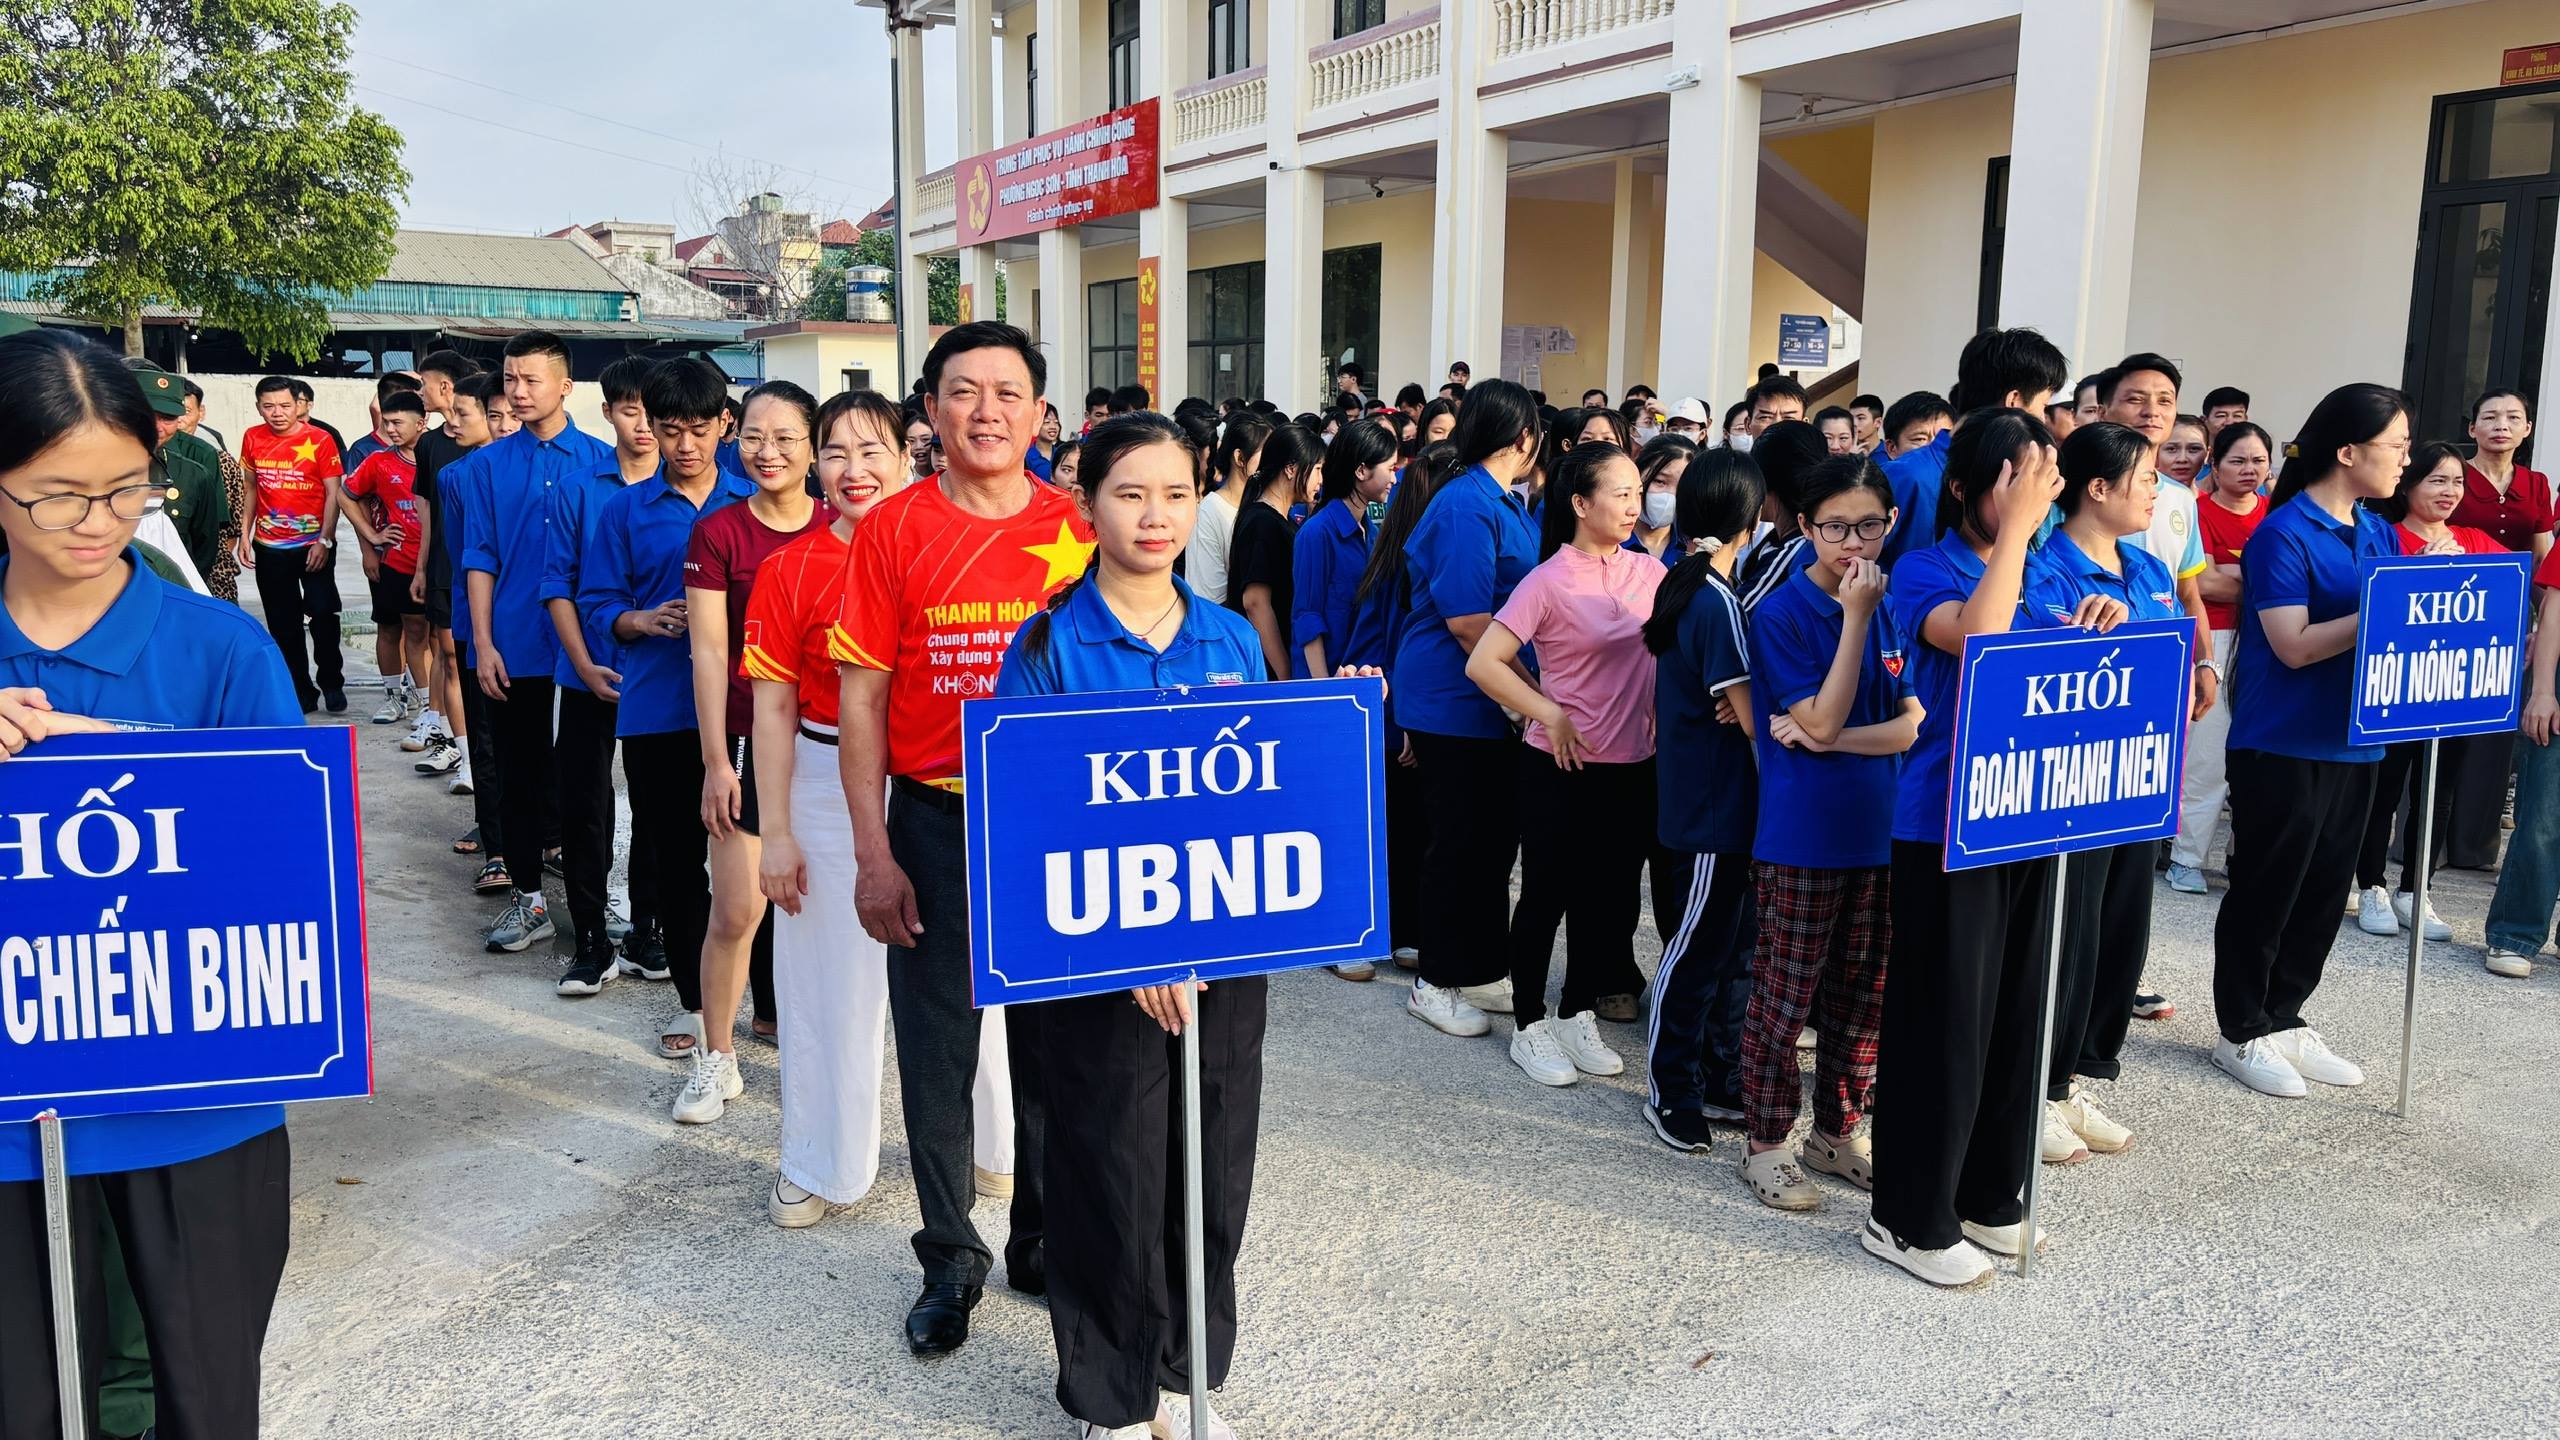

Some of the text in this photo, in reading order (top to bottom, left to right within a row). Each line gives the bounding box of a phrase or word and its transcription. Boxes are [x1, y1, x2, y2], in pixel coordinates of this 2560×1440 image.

[996, 116, 1136, 177] TRUNG TÂM PHỤC VỤ HÀNH CHÍNH CÔNG
[1000, 181, 1026, 206] PHƯỜNG
[1026, 178, 1045, 201] NGỌC
[1045, 173, 1061, 195] SƠN
[1065, 162, 1084, 189] TỈNH
[1084, 160, 1111, 185] THANH
[1111, 151, 1129, 178] HÓA
[1027, 199, 1094, 224] Hành chính phục vụ
[924, 597, 1038, 628] THANH HÓA
[2405, 574, 2489, 626] KHỐI
[927, 632, 968, 647] Chung
[973, 629, 1000, 647] một
[929, 650, 953, 667] Xây
[957, 649, 992, 667] dựng
[2022, 647, 2135, 717] KHỐI
[2364, 635, 2514, 718] HỘI NÔNG DÂN
[1084, 715, 1282, 806] KHỐI
[1967, 721, 2170, 821] ĐOÀN THANH NIÊN
[1045, 831, 1323, 936] UBND
[0, 895, 323, 1045] CHIẾN BINH
